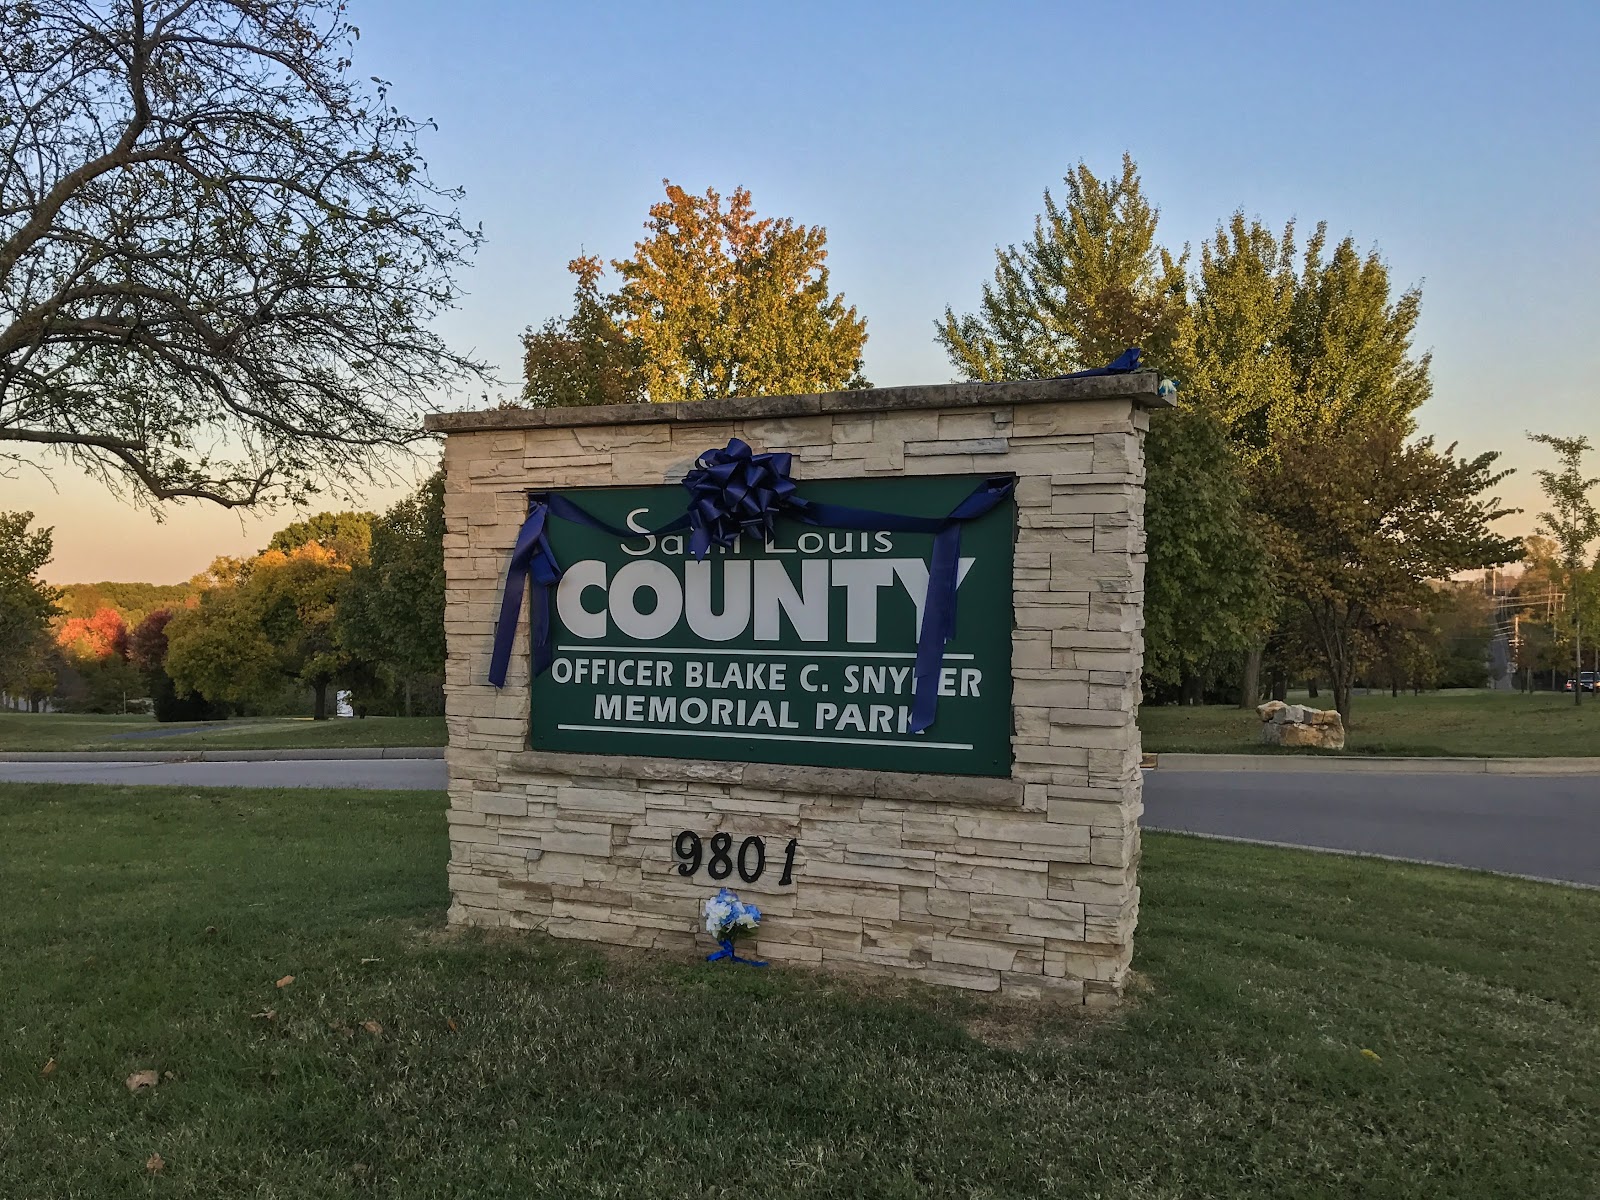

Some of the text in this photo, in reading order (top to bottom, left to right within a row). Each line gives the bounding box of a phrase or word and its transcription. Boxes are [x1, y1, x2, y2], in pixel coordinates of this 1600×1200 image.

[764, 526, 894, 555] Louis
[556, 557, 976, 645] COUNTY
[551, 657, 982, 698] OFFICER BLAKE C. SNYER
[594, 694, 799, 730] MEMORIAL
[675, 830, 797, 886] 9801
